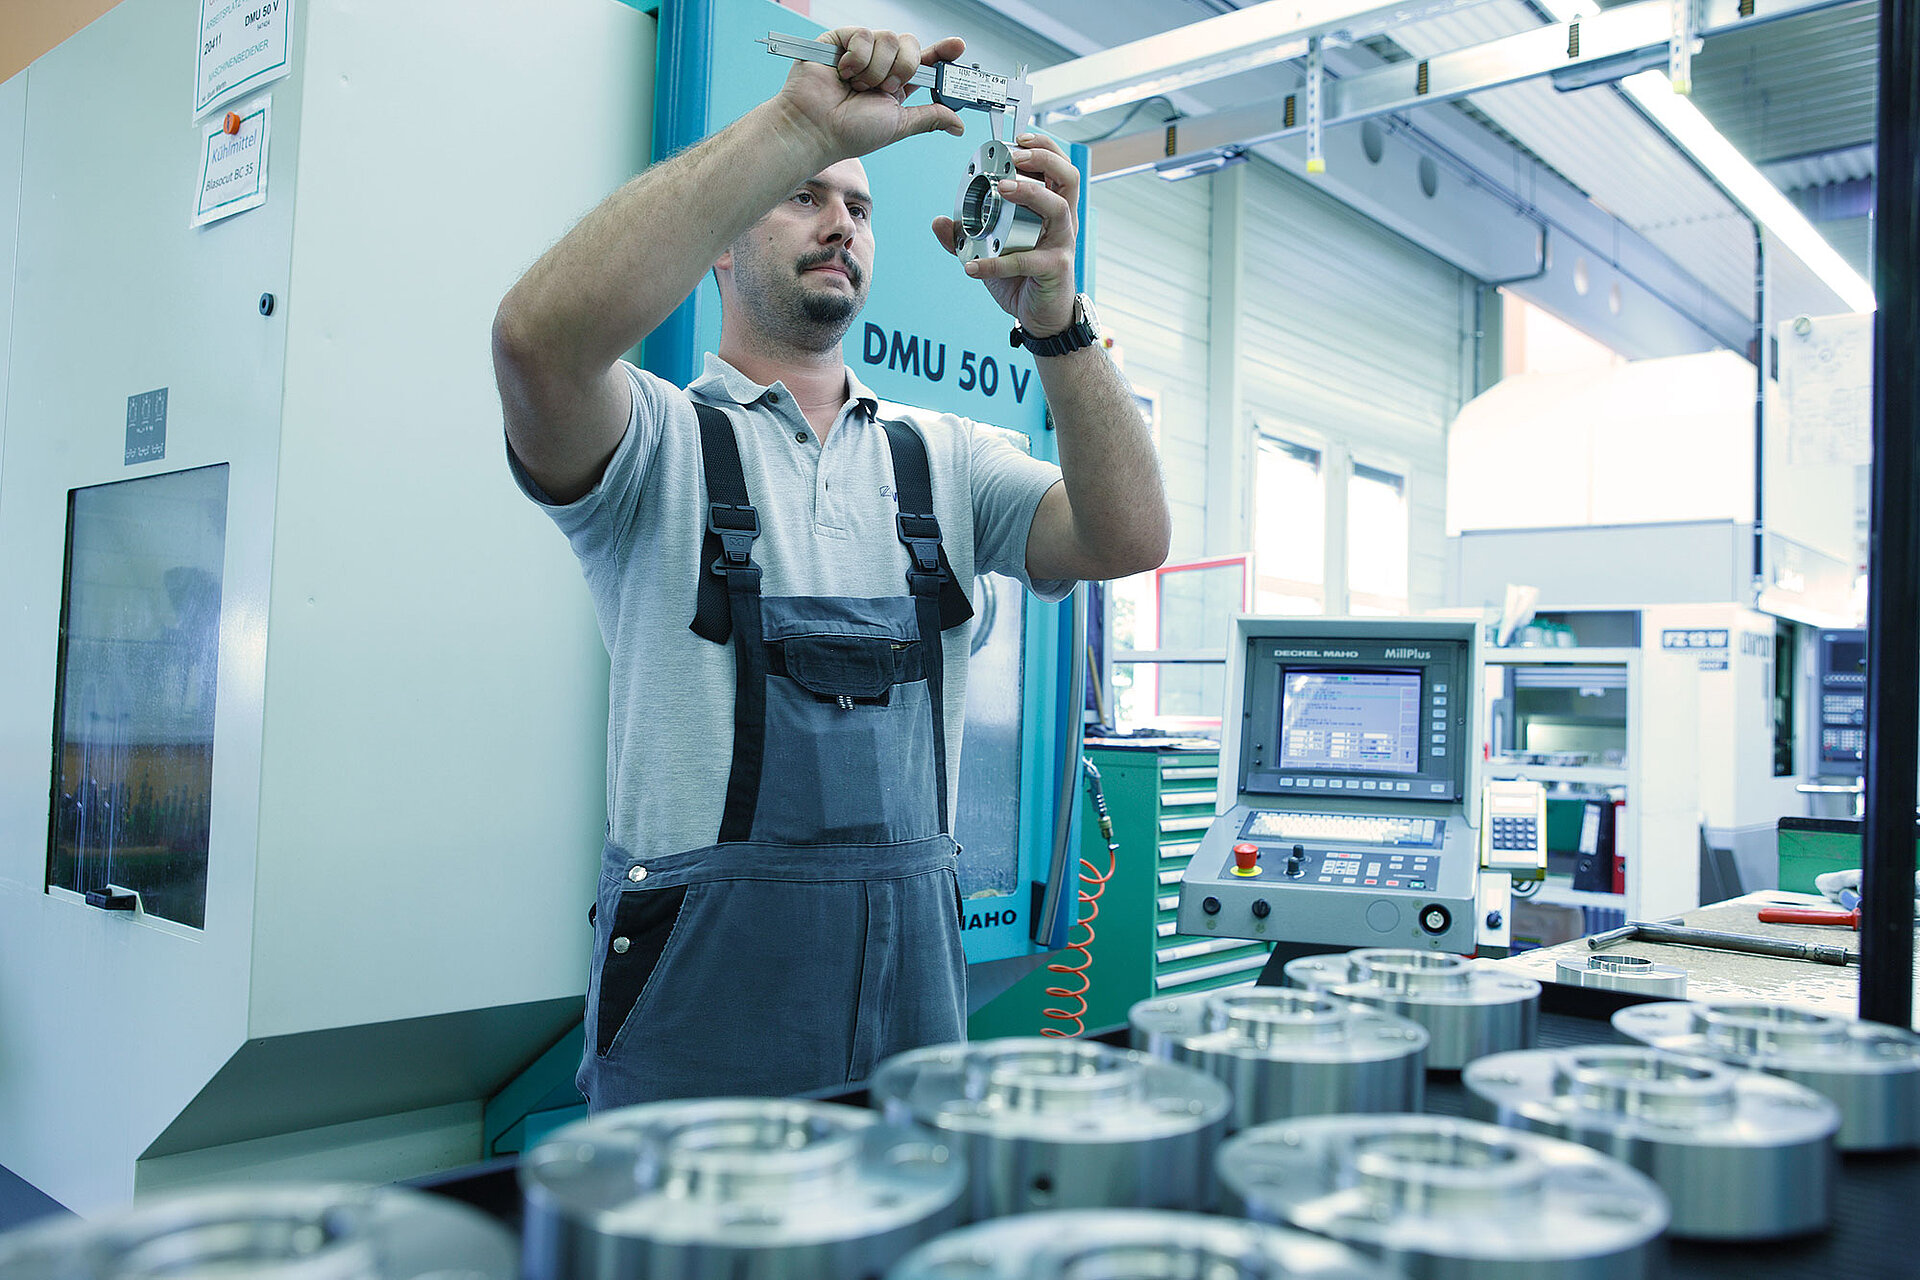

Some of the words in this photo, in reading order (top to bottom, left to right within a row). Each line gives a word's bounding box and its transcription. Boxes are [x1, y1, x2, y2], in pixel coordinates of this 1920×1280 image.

[245, 9, 261, 27] DMU
[262, 3, 272, 18] 50
[273, 0, 279, 11] V
[212, 128, 258, 164] Kühlmittel
[863, 321, 946, 382] DMU
[959, 350, 998, 397] 50
[1009, 363, 1032, 404] V
[1274, 649, 1321, 658] DECKEL
[1323, 650, 1359, 659] MAHO
[1384, 648, 1432, 660] MillPlus
[961, 909, 1017, 931] AHO
